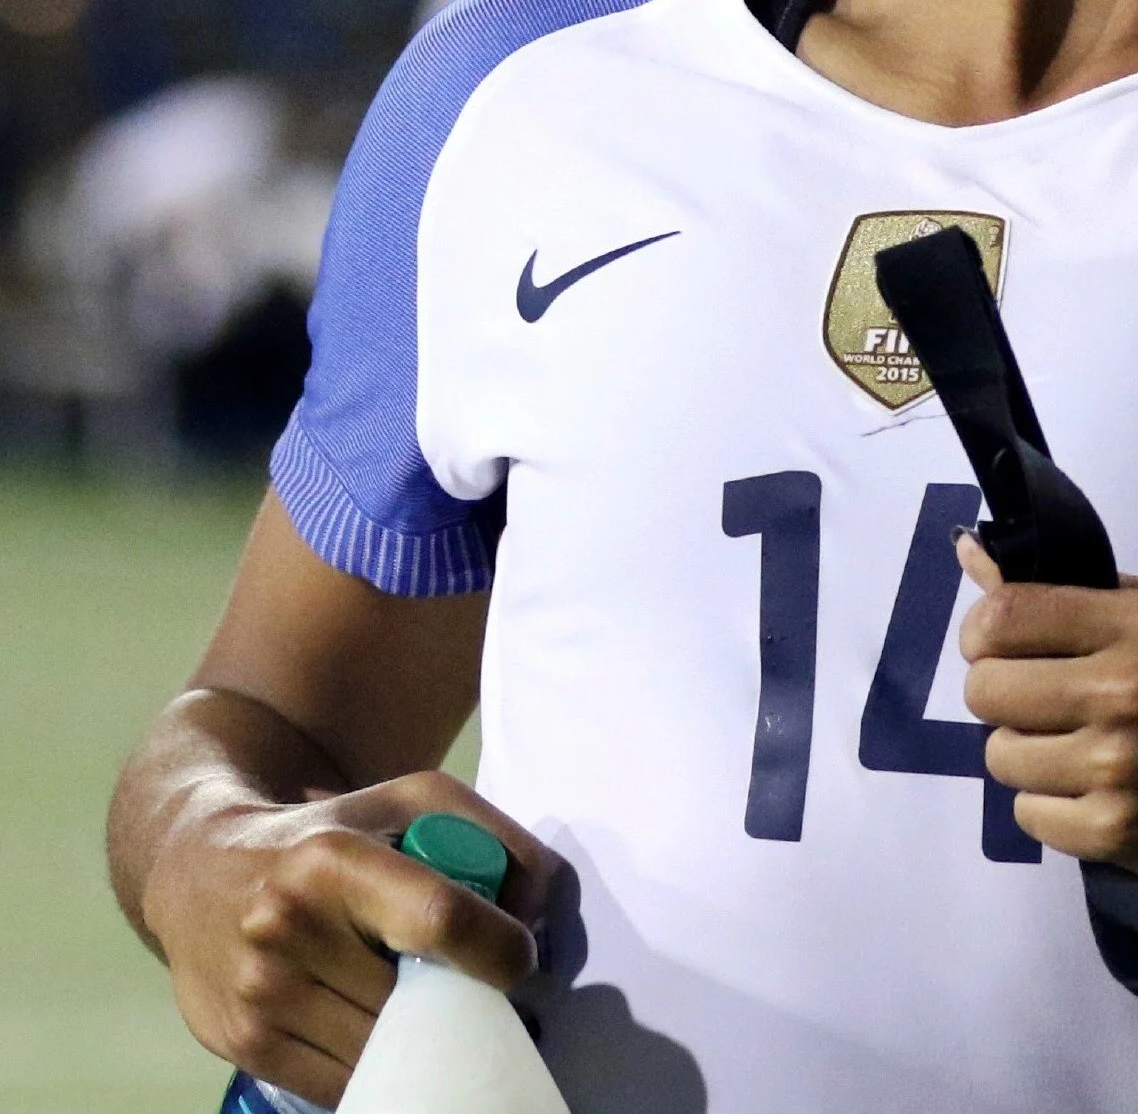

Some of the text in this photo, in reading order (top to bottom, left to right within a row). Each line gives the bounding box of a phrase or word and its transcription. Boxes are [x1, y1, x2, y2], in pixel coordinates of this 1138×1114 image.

[843, 353, 886, 365] WORLD
[875, 366, 920, 382] 2015
[721, 469, 1043, 864] 14
